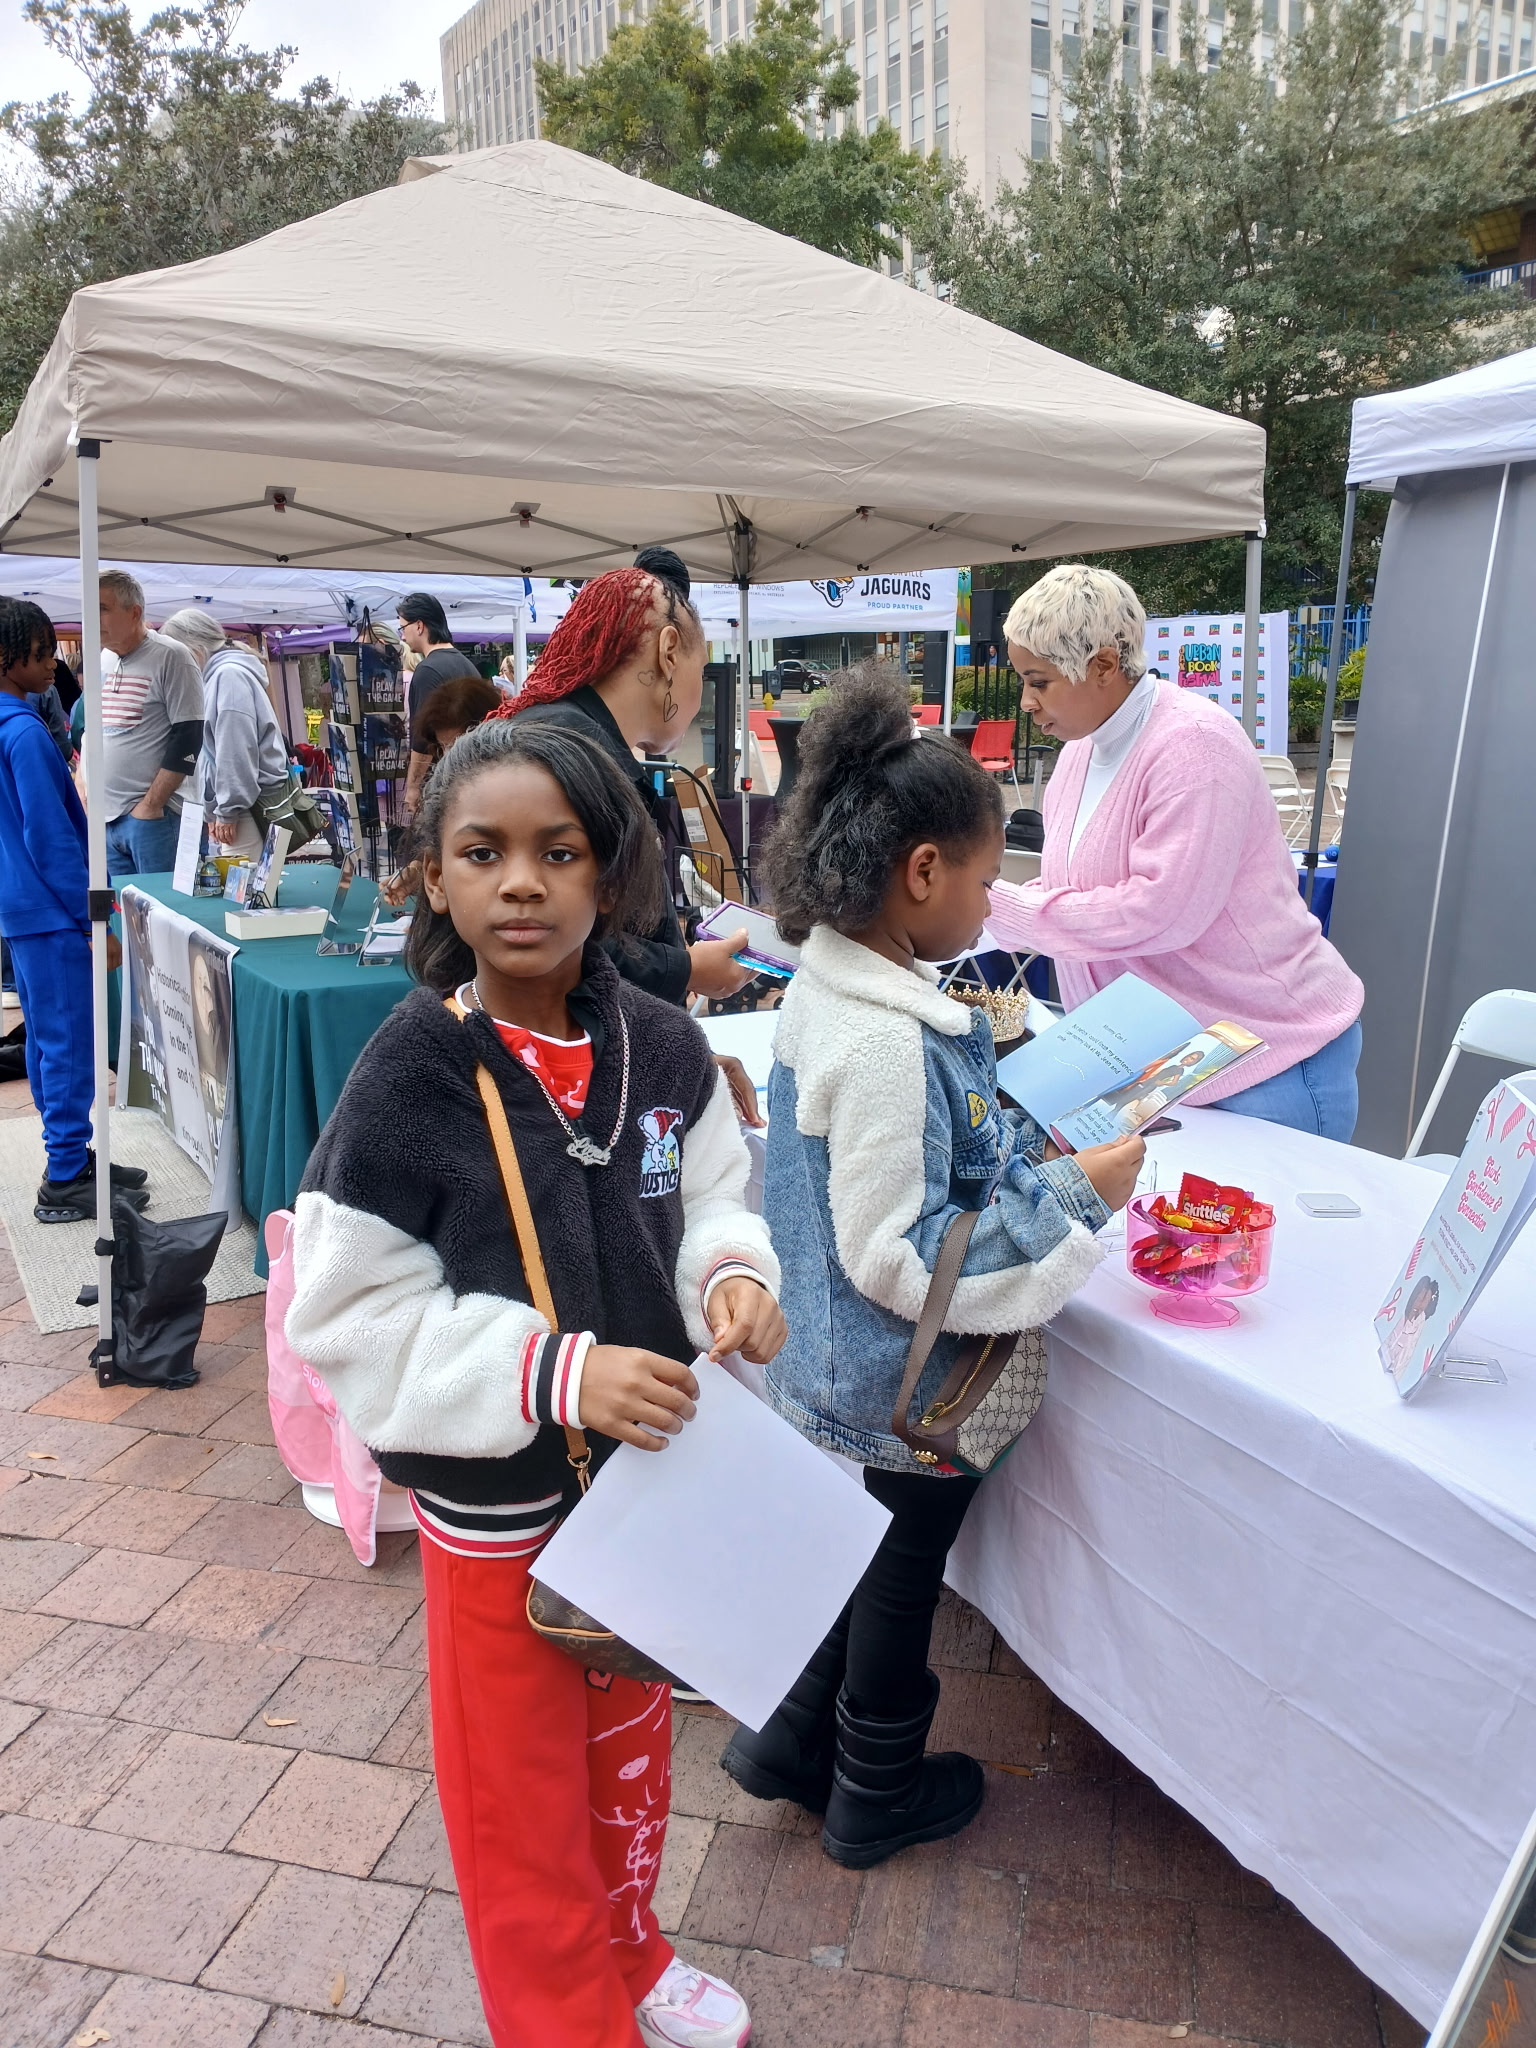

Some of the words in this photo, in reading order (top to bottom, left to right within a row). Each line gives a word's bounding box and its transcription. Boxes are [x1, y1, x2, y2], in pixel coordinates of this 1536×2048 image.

[860, 577, 931, 601] JAGUARS
[867, 601, 891, 609] PROUD
[892, 603, 924, 611] PARTNER
[375, 681, 394, 692] PLAY
[379, 749, 397, 760] PLAY
[1107, 1049, 1115, 1057] my
[1113, 1055, 1135, 1076] sentence
[1110, 1065, 1121, 1075] and
[1465, 1170, 1495, 1209] Confidence
[1183, 1202, 1230, 1225] Skittles
[1457, 1192, 1488, 1233] Connection
